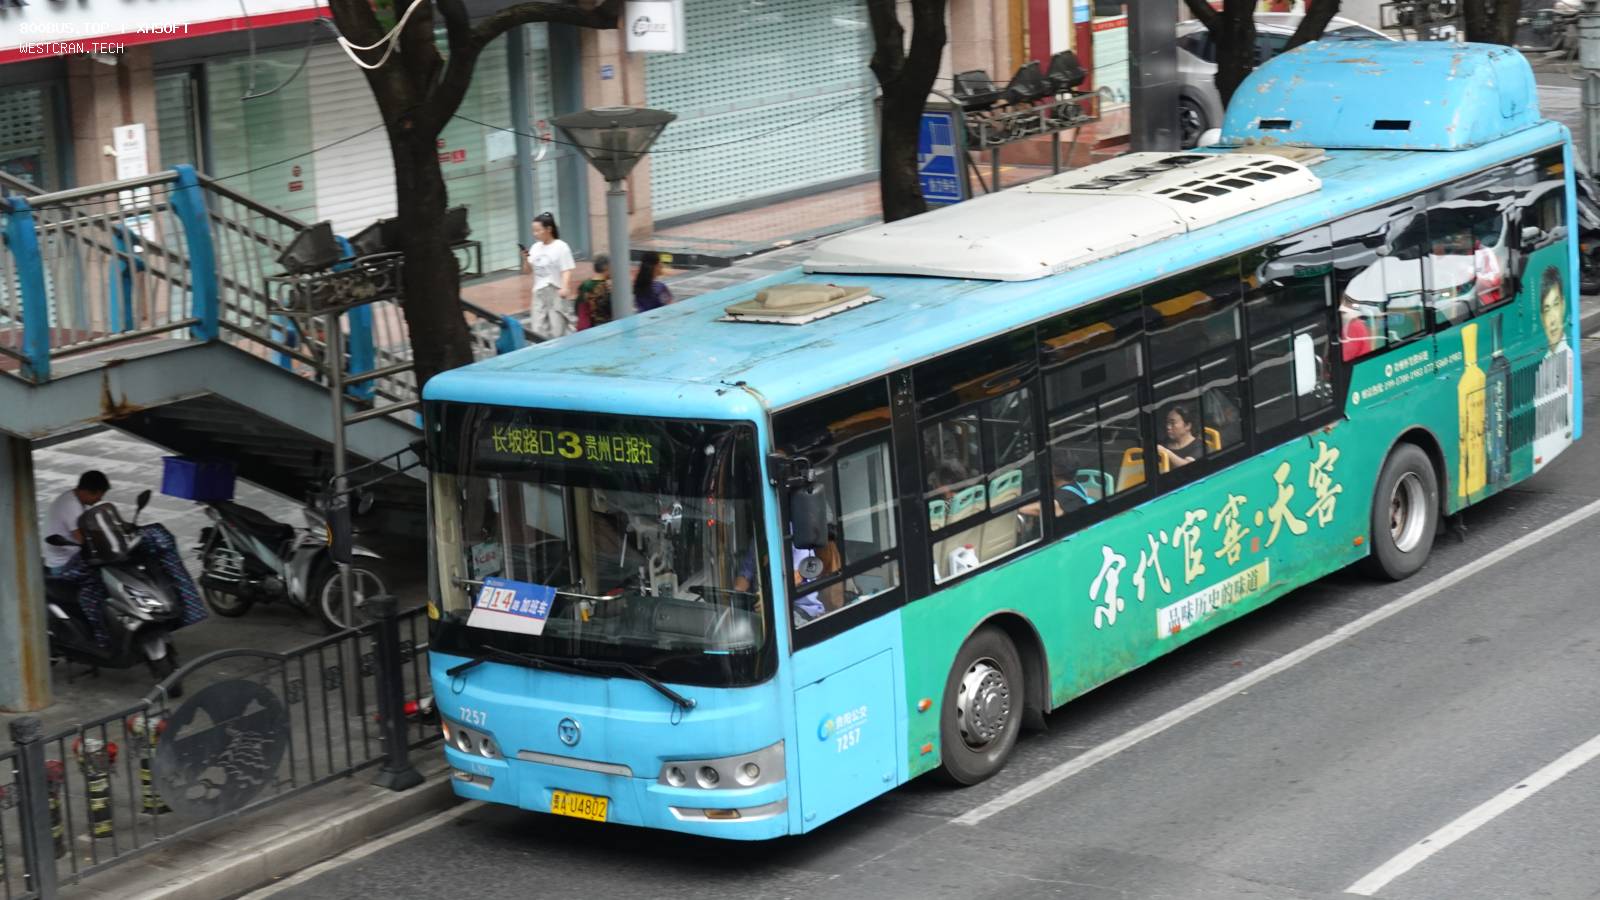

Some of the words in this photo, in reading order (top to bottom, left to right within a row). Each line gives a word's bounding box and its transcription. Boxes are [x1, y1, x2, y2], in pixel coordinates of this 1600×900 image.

[557, 431, 583, 458] 3
[585, 434, 653, 464] 贵州日报社
[460, 707, 487, 727] 7257
[836, 727, 860, 752] 7257
